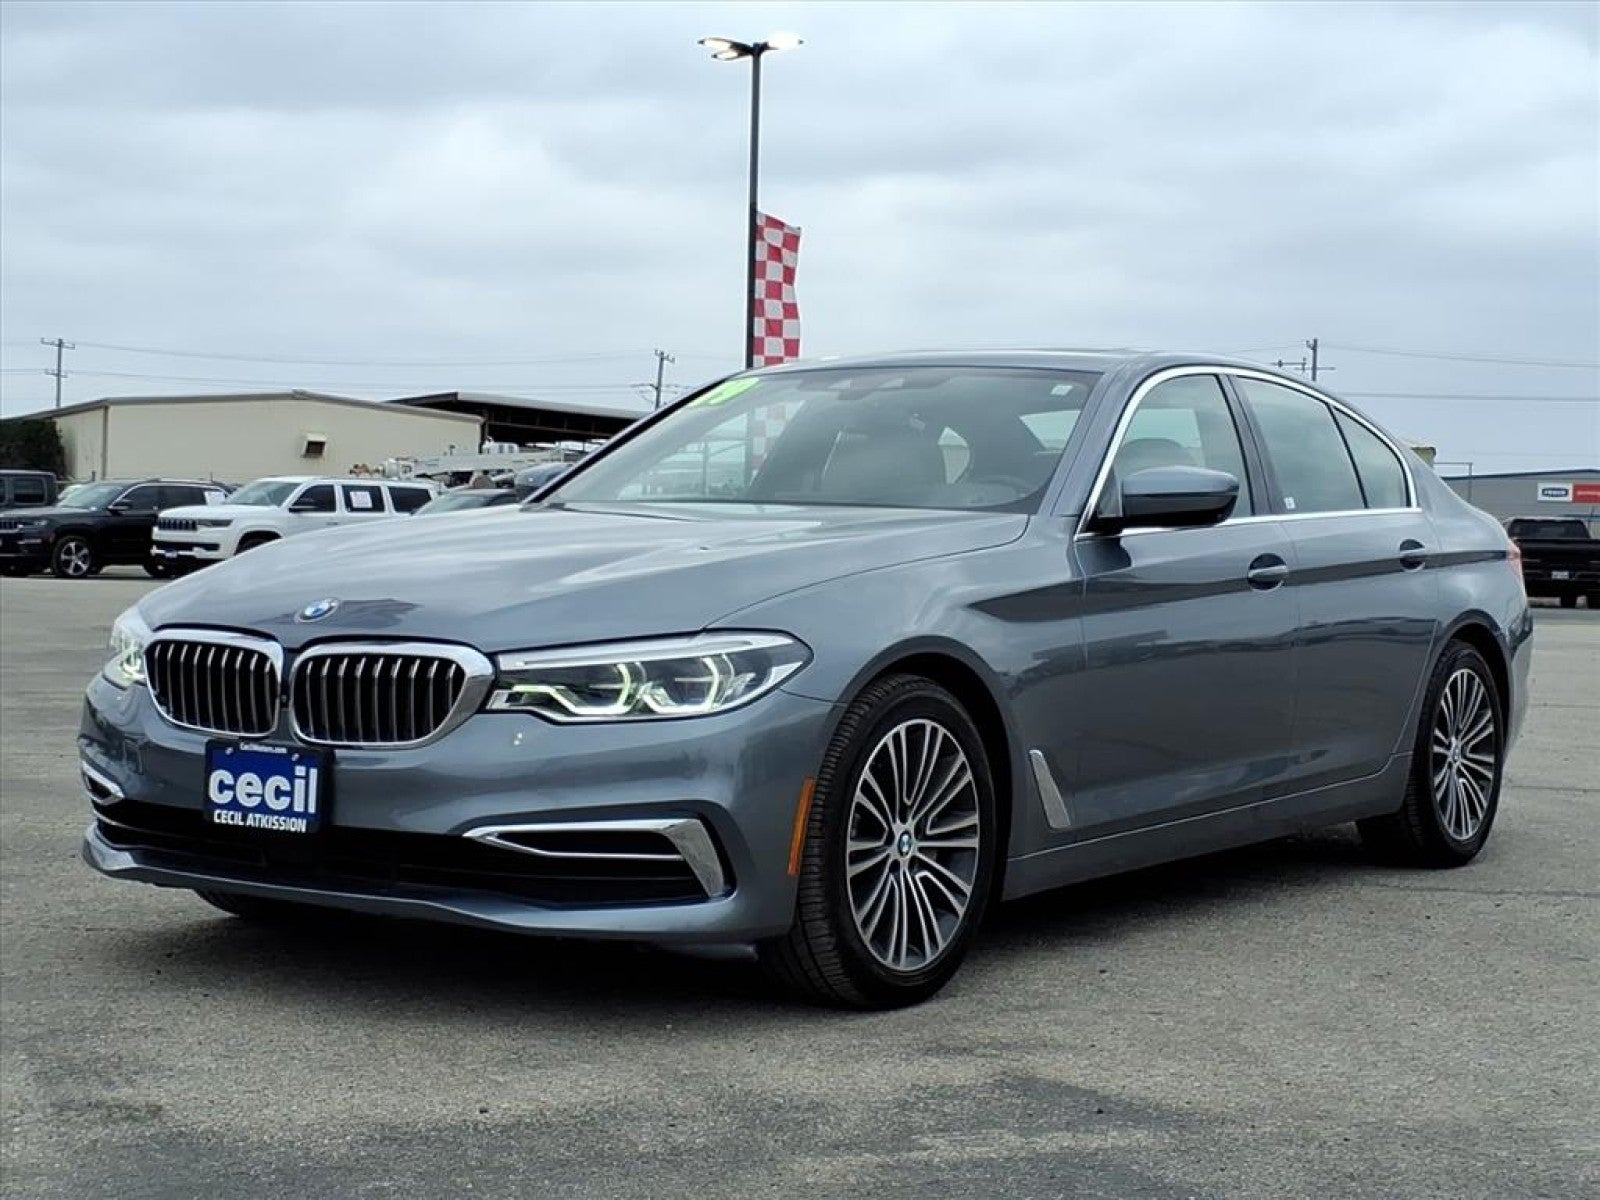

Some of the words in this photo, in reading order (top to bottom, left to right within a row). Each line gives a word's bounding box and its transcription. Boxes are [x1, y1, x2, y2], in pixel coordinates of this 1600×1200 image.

[209, 765, 318, 813] cecil
[213, 809, 244, 825] CECIL
[246, 812, 307, 833] ATKISSION
